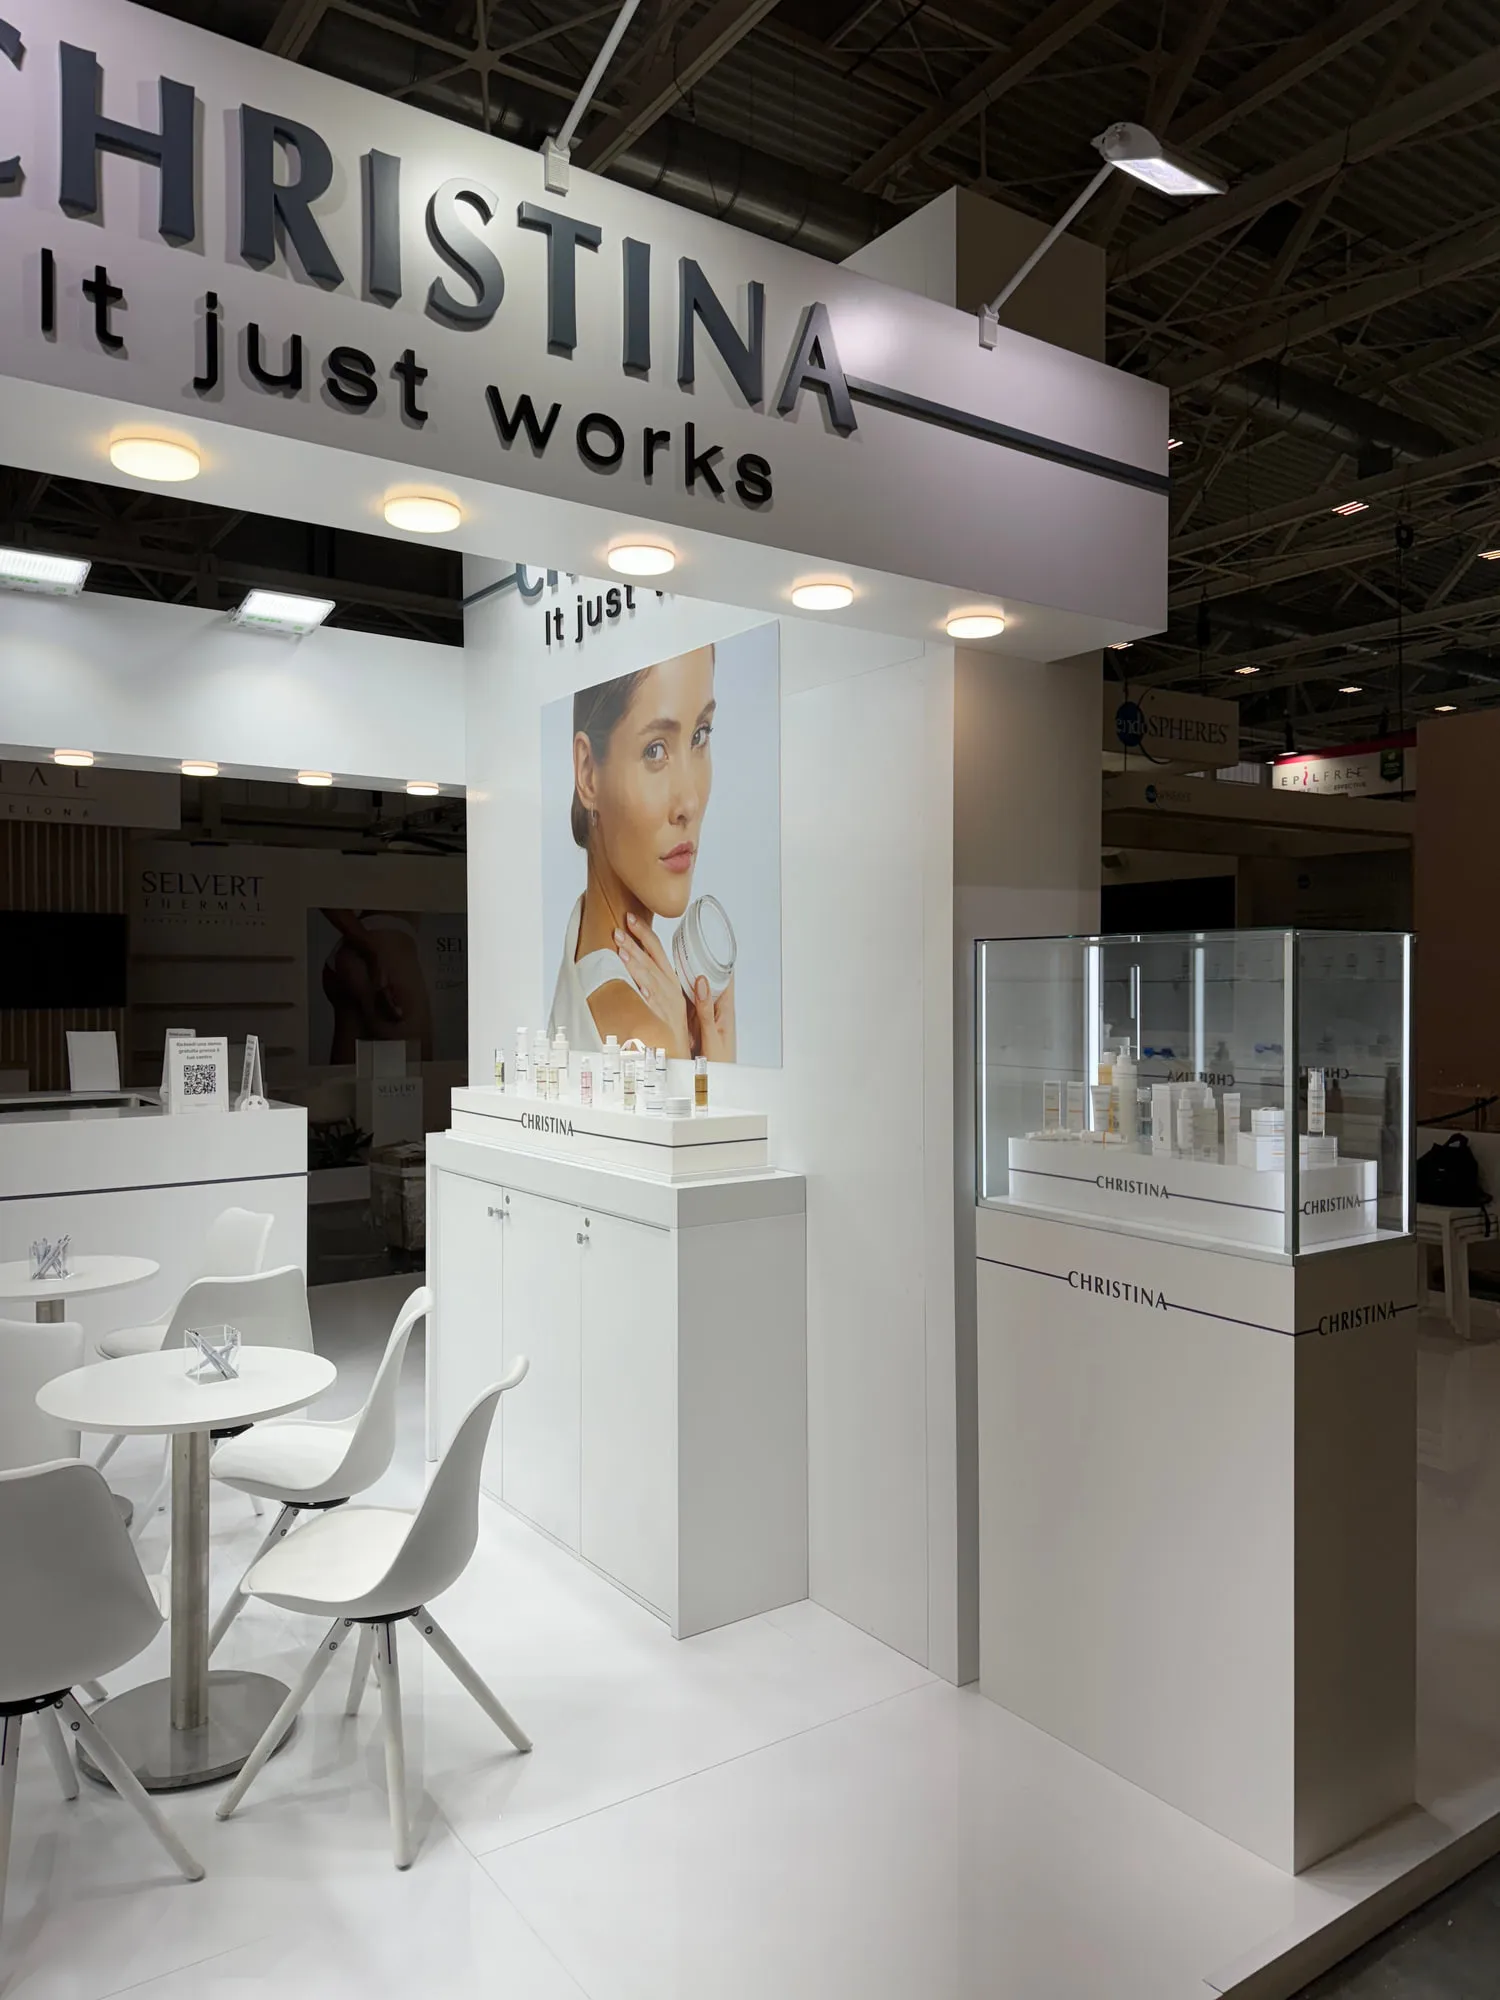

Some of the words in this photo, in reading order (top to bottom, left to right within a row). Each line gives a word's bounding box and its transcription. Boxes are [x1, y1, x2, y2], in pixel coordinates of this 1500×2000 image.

[0, 18, 858, 435] HRISTINA
[40, 247, 124, 348] It
[193, 290, 428, 422] just
[486, 384, 773, 503] works
[545, 606, 564, 645] It
[141, 870, 265, 898] SELVERT
[143, 897, 266, 912] THERMAL
[521, 1112, 574, 1137] CHRISTINA
[1096, 1174, 1169, 1199] CHRISTINA
[1303, 1195, 1361, 1216] CHRISTINA
[1067, 1270, 1168, 1311] CHRISTINA
[1318, 1300, 1396, 1336] CHRISTINA
